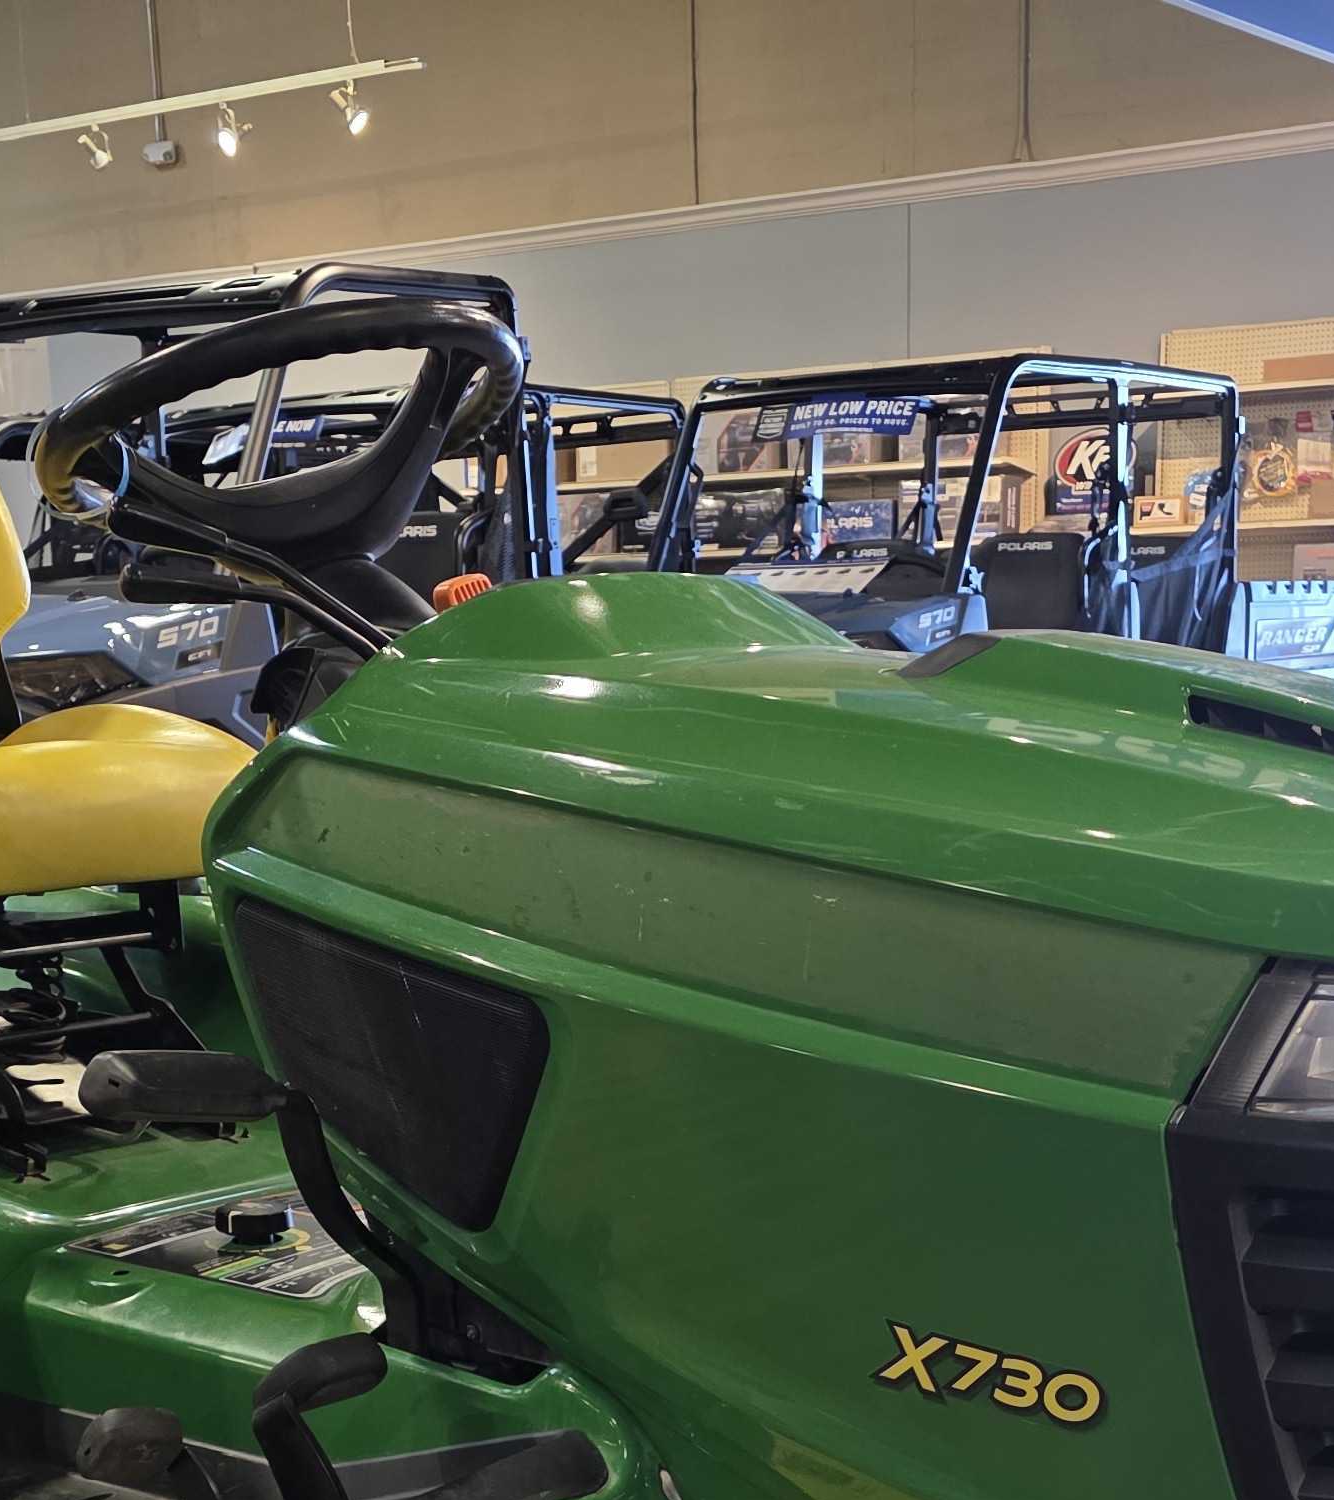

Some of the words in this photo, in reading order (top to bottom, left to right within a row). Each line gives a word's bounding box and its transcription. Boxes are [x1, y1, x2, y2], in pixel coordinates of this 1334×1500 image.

[793, 402, 828, 421] NEW
[828, 400, 866, 416] LOW
[865, 400, 916, 416] PRICE
[285, 418, 316, 432] NOW
[839, 417, 869, 425] PRICED
[871, 417, 882, 425] TO
[997, 541, 1053, 552] POLARIS
[918, 606, 956, 629] 570
[157, 615, 220, 649] 570
[1257, 627, 1328, 646] RANGER
[875, 1322, 1104, 1425] X730
